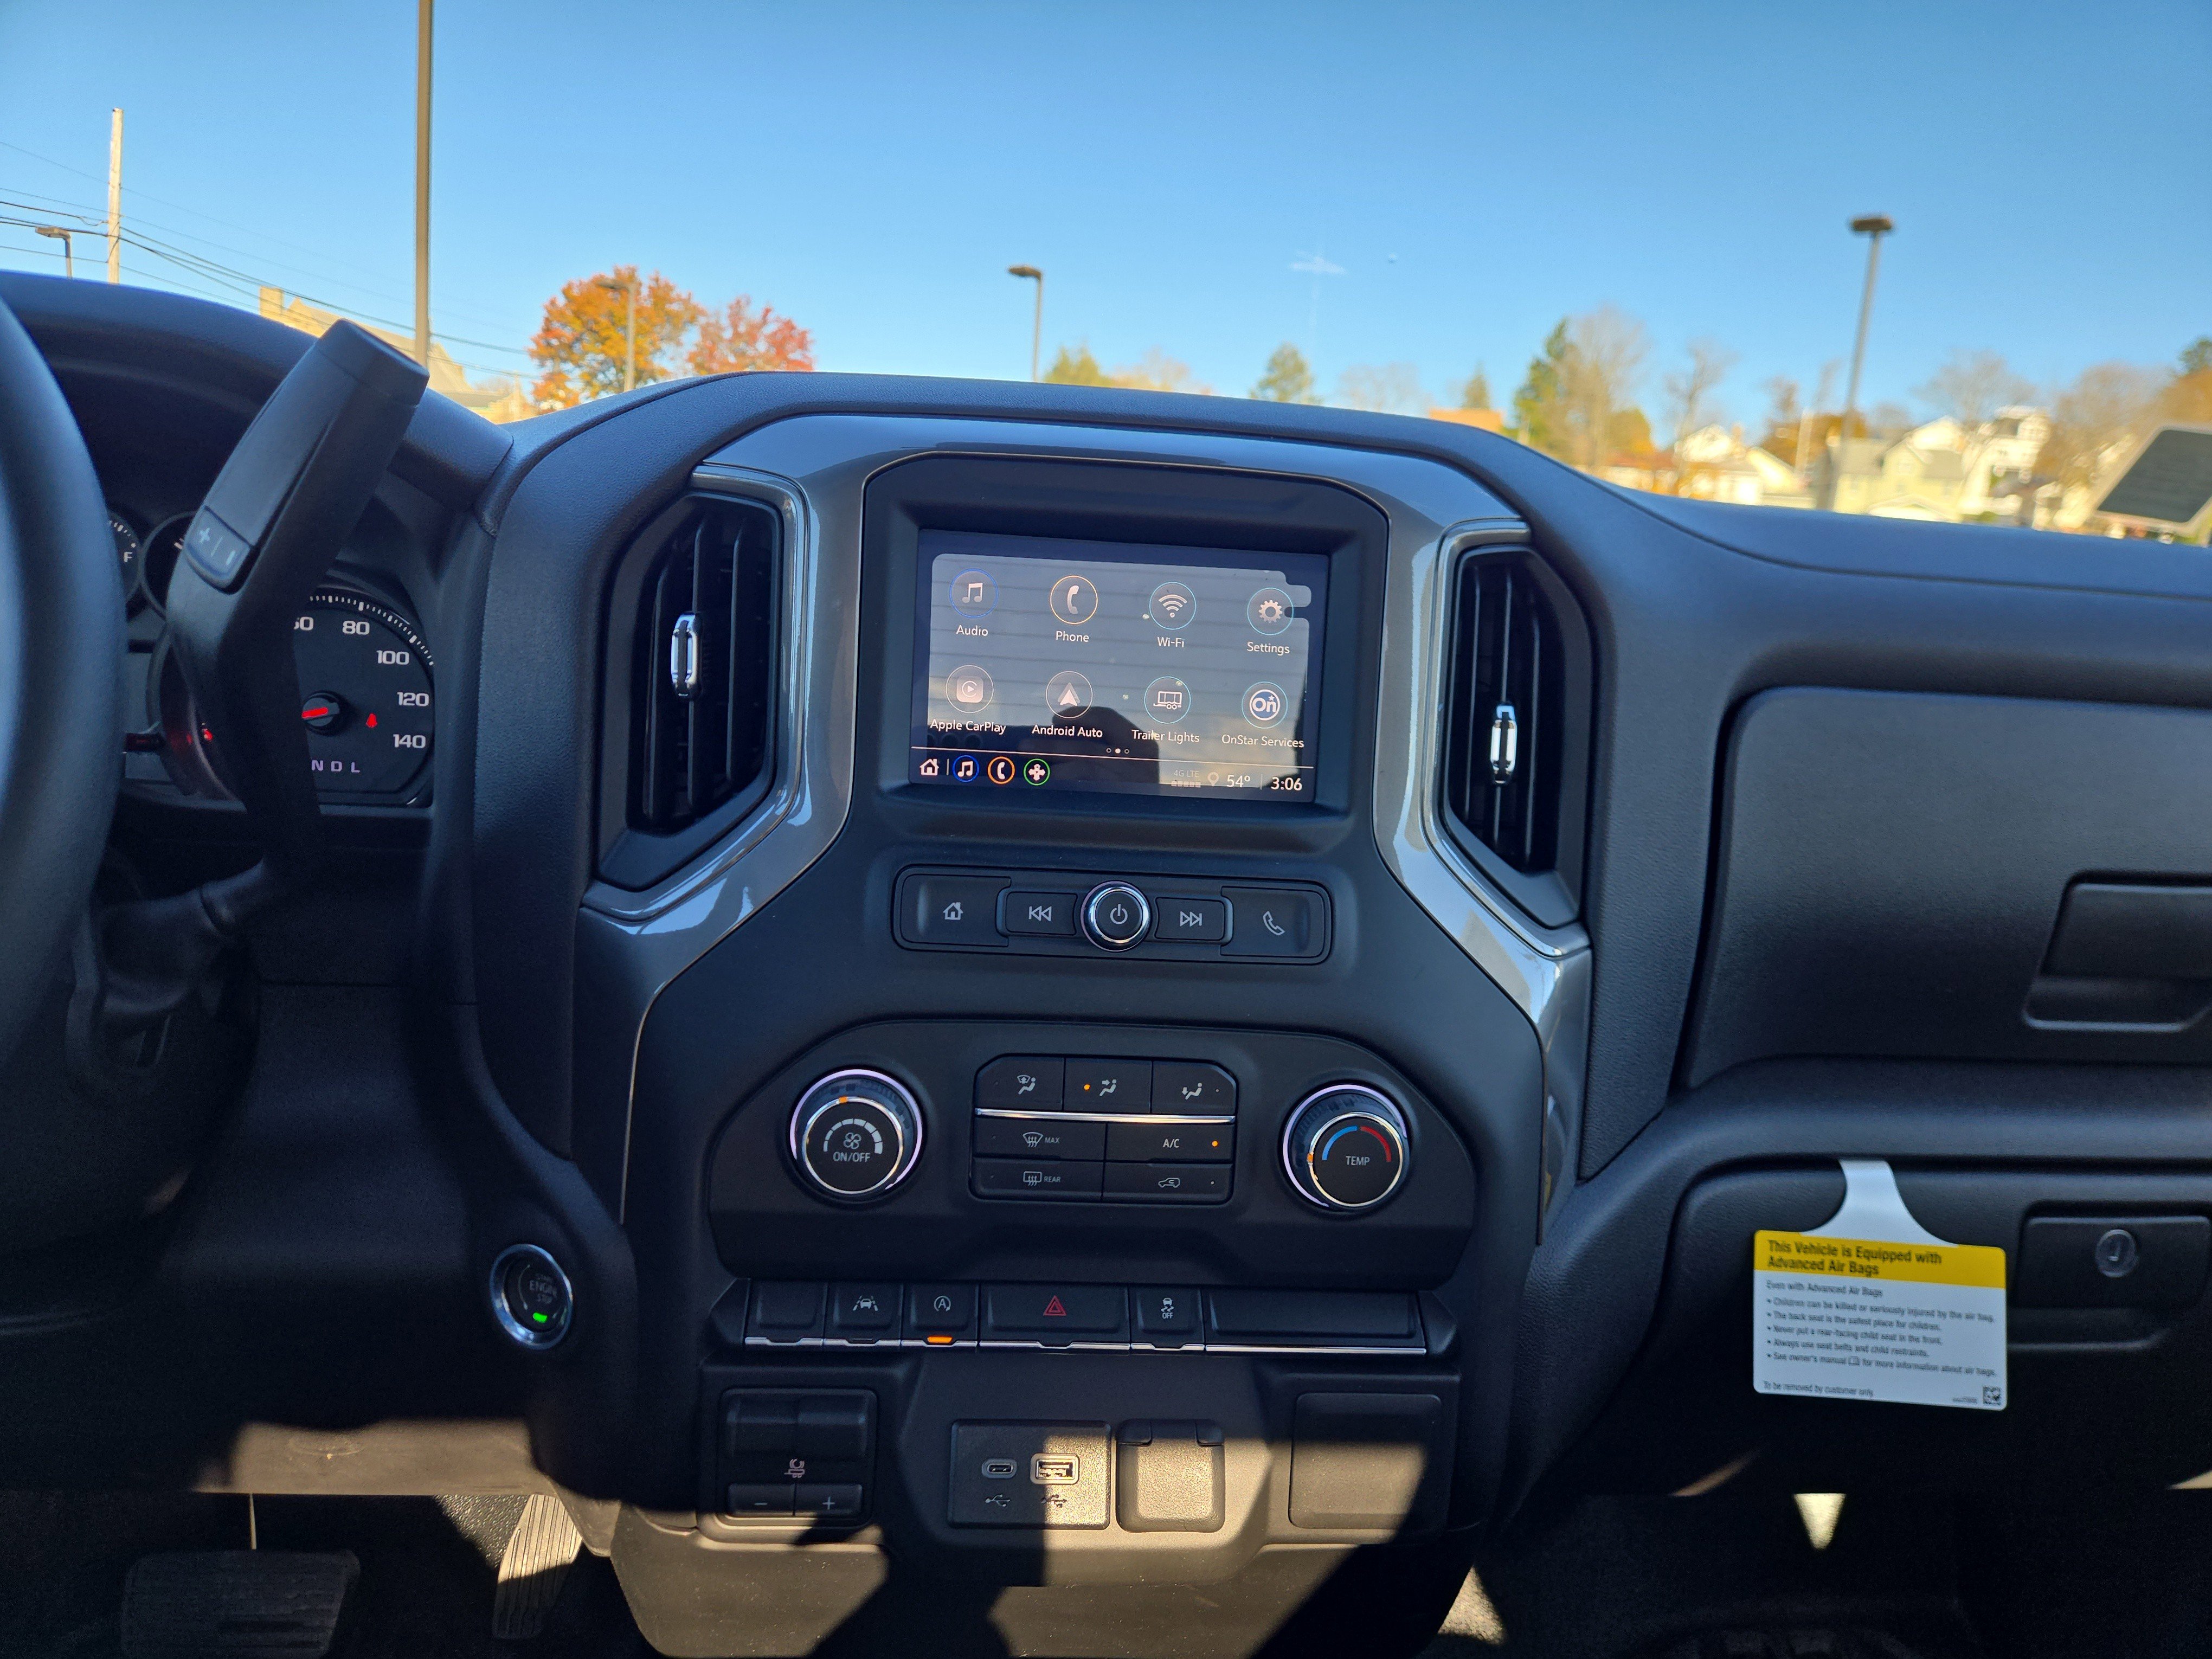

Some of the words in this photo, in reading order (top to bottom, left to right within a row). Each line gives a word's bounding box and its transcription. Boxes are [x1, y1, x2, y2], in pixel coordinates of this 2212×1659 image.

[124, 551, 133, 562] F
[342, 620, 370, 635] 80
[956, 625, 988, 636] Audio
[1056, 631, 1090, 642] Phone
[1157, 636, 1185, 648] Wi-Fi
[1246, 641, 1290, 655] Settings
[376, 650, 410, 665] 100
[397, 692, 429, 706] 120
[1252, 697, 1276, 712] On
[930, 718, 962, 732] Apple
[966, 721, 1006, 735] CarPlay
[1031, 724, 1076, 736] Android
[1077, 727, 1103, 738] Auto
[393, 734, 426, 748] 140
[1131, 729, 1165, 741] Trailer
[1168, 731, 1200, 744] Lights
[1221, 734, 1258, 745] OnStar
[1261, 736, 1304, 748] Services
[311, 760, 324, 771] N
[331, 761, 343, 772] D
[351, 762, 361, 773] L
[1173, 769, 1185, 777] 4G
[1186, 770, 1200, 778] LTE
[1270, 776, 1302, 791] 3:06
[1162, 1138, 1180, 1148] A/C
[833, 1151, 870, 1162] ON/OFF
[1346, 1155, 1371, 1166] TEMP
[1768, 1240, 1792, 1252] This
[1795, 1241, 1838, 1256] Vehicle
[1842, 1245, 1853, 1257] is
[1856, 1246, 1912, 1263] Equipped
[1915, 1252, 1942, 1264] with
[1768, 1256, 1825, 1270] Advanced
[1829, 1259, 1845, 1271] Air
[1849, 1261, 1880, 1276] Bags
[1767, 1280, 1785, 1289] Even
[1787, 1282, 1805, 1290] with
[1808, 1283, 1847, 1293] Advanced
[1849, 1286, 1860, 1294] Air
[1862, 1287, 1883, 1297] Bags
[1773, 1297, 1805, 1306] Children
[1870, 1306, 1905, 1315] seriously
[1907, 1306, 1935, 1317] injured
[1937, 1309, 1947, 1319] by
[1950, 1310, 1963, 1318] the
[1773, 1311, 1786, 1319] The
[1849, 1317, 1871, 1326] safest
[1873, 1319, 1894, 1328] place
[1860, 1331, 1879, 1339] child
[1774, 1339, 1799, 1349] Always
[1871, 1346, 1889, 1354] child
[1819, 1356, 1847, 1364] manual
[1896, 1360, 1939, 1371] information
[1941, 1365, 1963, 1373] about
[1783, 1384, 1813, 1392] removed
